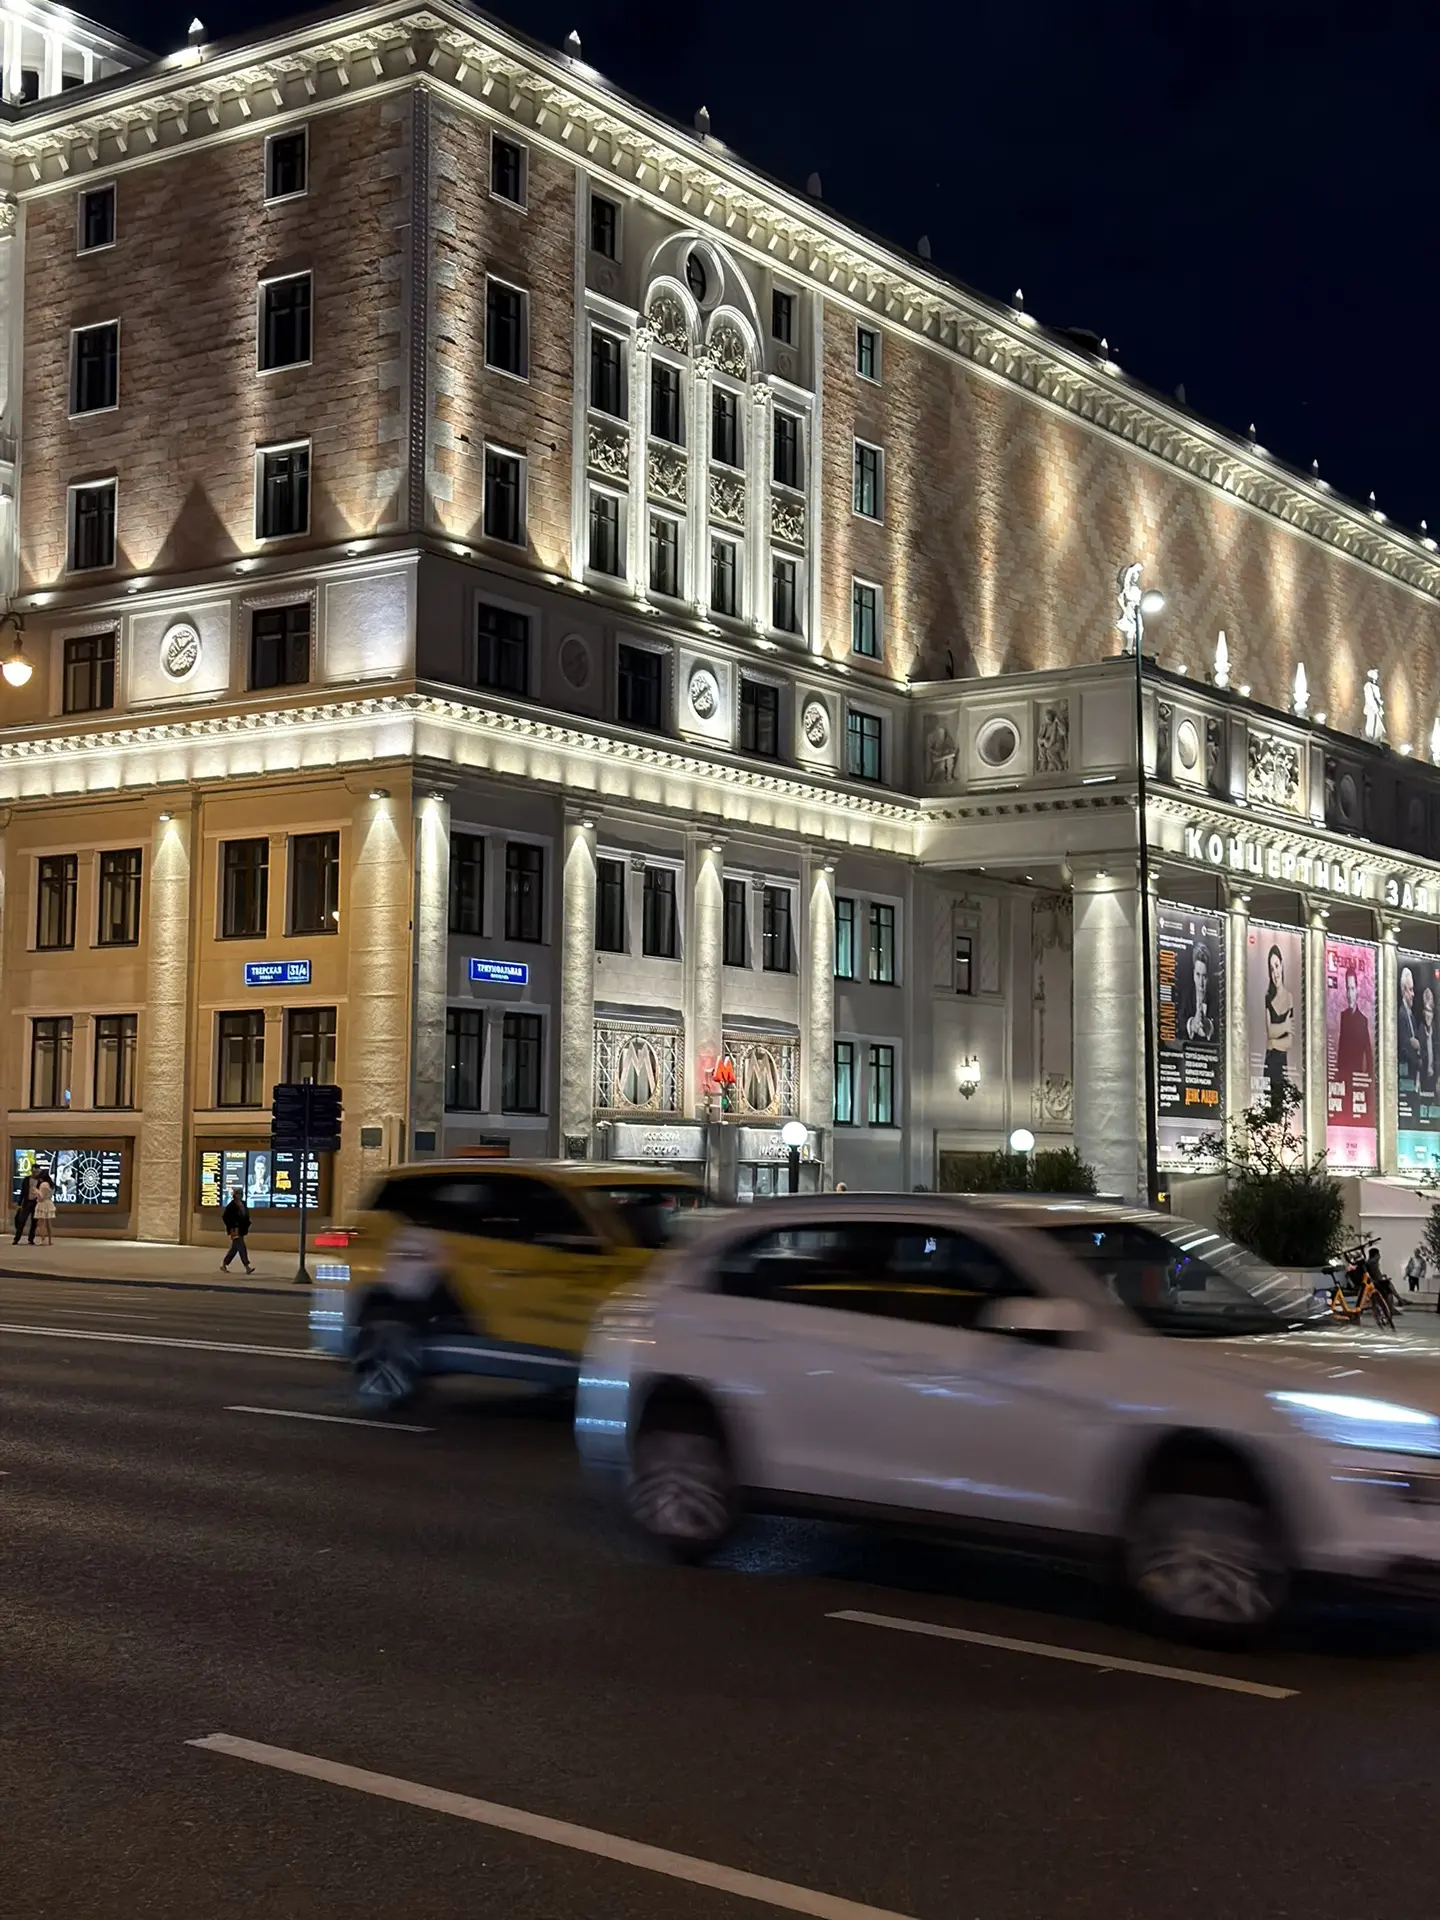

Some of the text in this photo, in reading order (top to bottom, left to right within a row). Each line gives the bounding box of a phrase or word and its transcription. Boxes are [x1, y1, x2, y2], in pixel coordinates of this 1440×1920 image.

[251, 966, 283, 975] ТВЕРСКАЯ
[289, 964, 307, 977] 31/4
[477, 963, 523, 977] ТРИУМФАЛЬНАЯ
[714, 1056, 736, 1083] М
